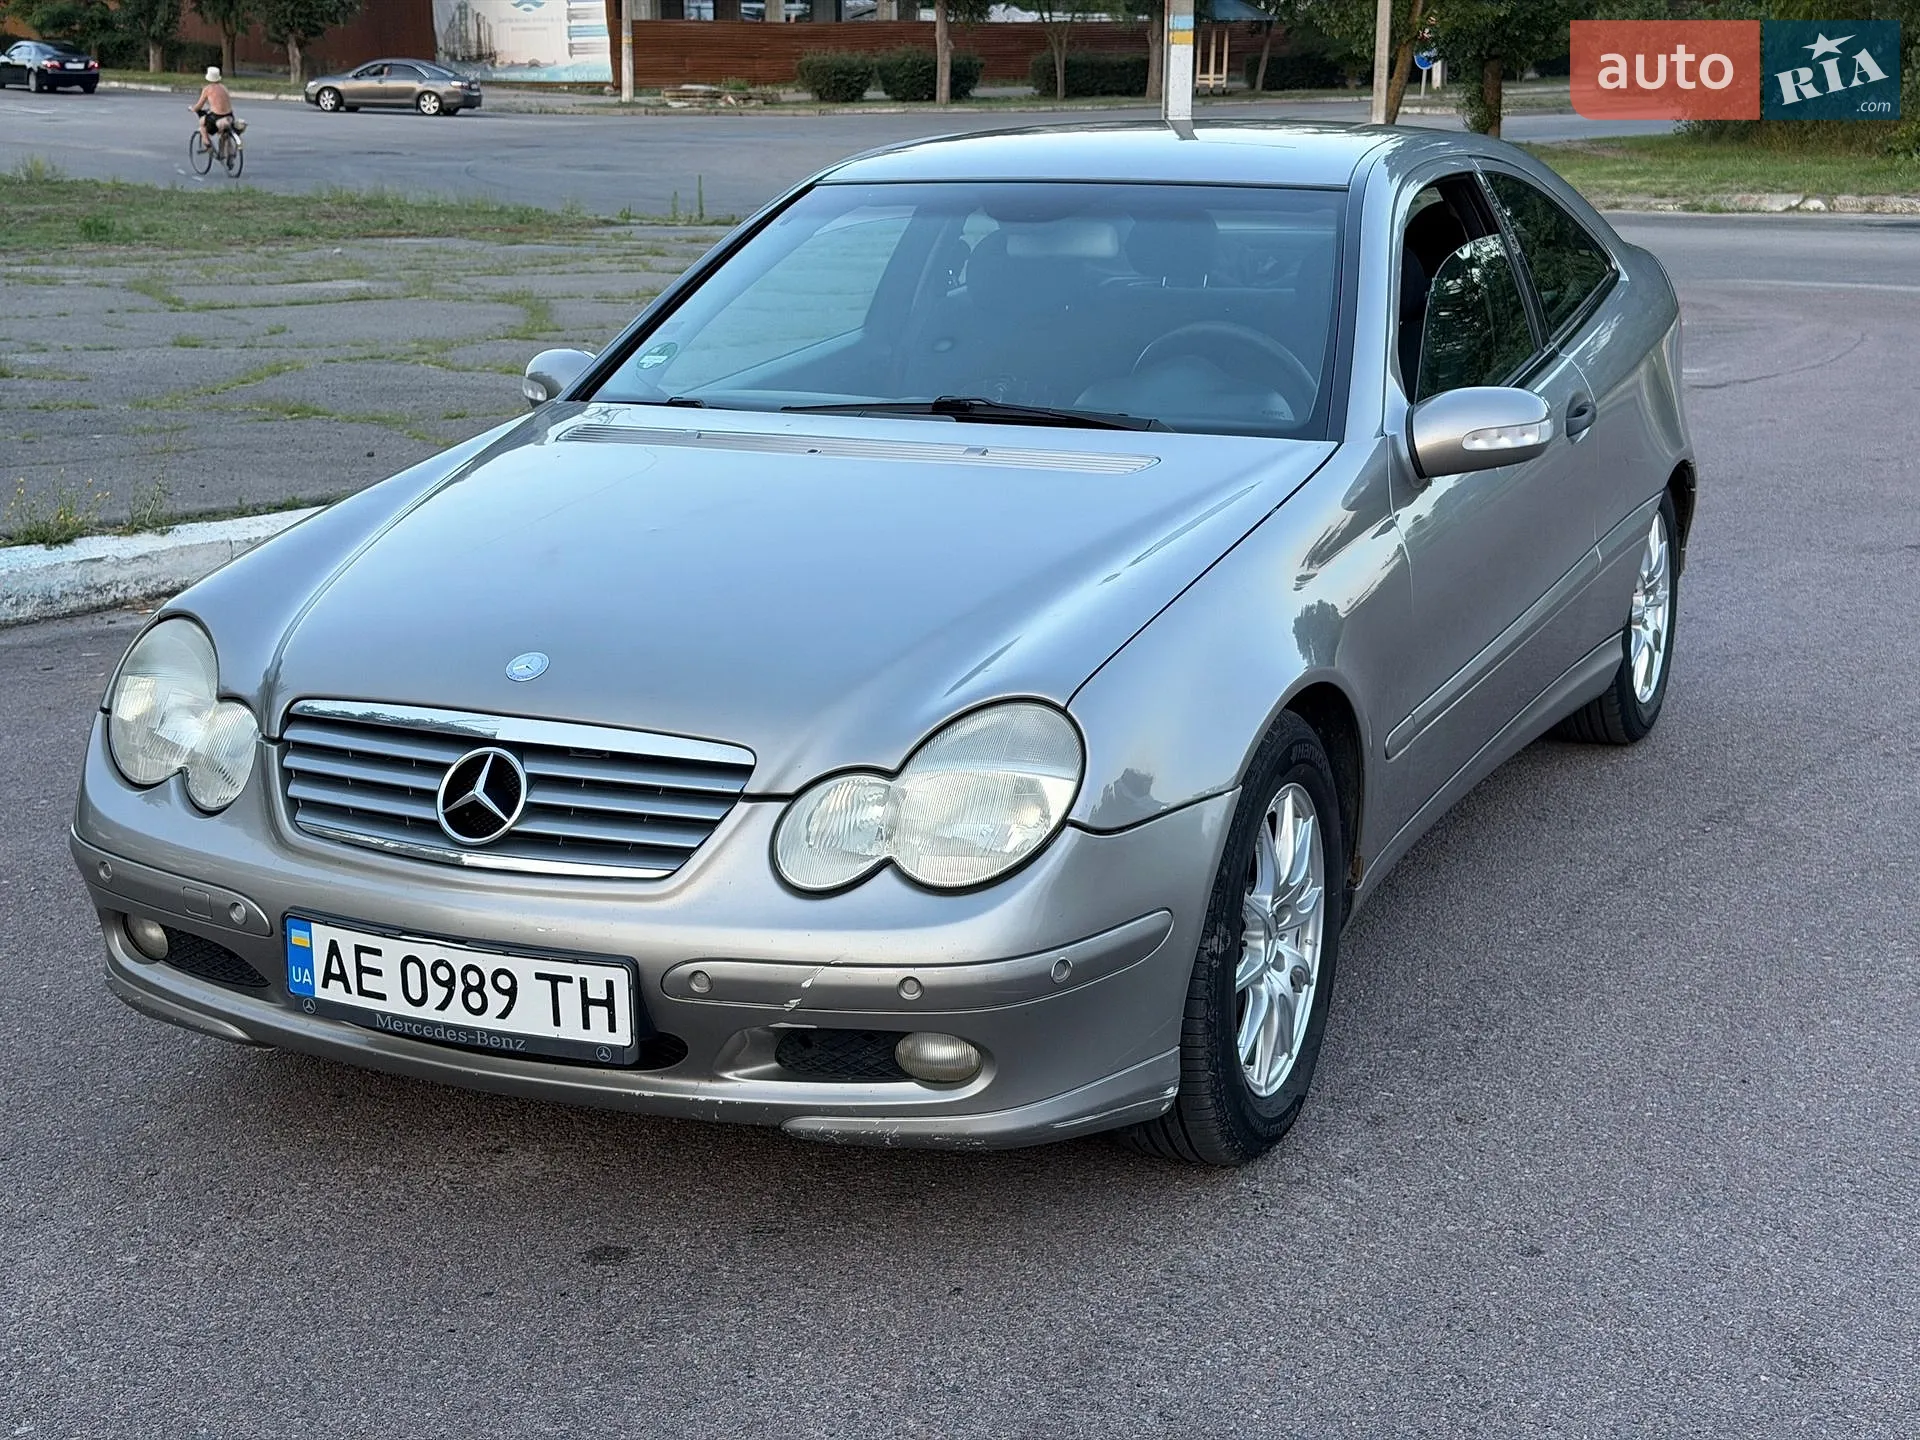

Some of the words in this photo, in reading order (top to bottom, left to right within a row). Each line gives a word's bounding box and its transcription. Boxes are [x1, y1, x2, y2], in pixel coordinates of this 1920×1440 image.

[292, 965, 313, 986] UA
[321, 939, 387, 1001] AE
[400, 954, 518, 1020] 0989
[535, 972, 616, 1033] TH
[375, 1012, 527, 1052] Mercedes-Benz
